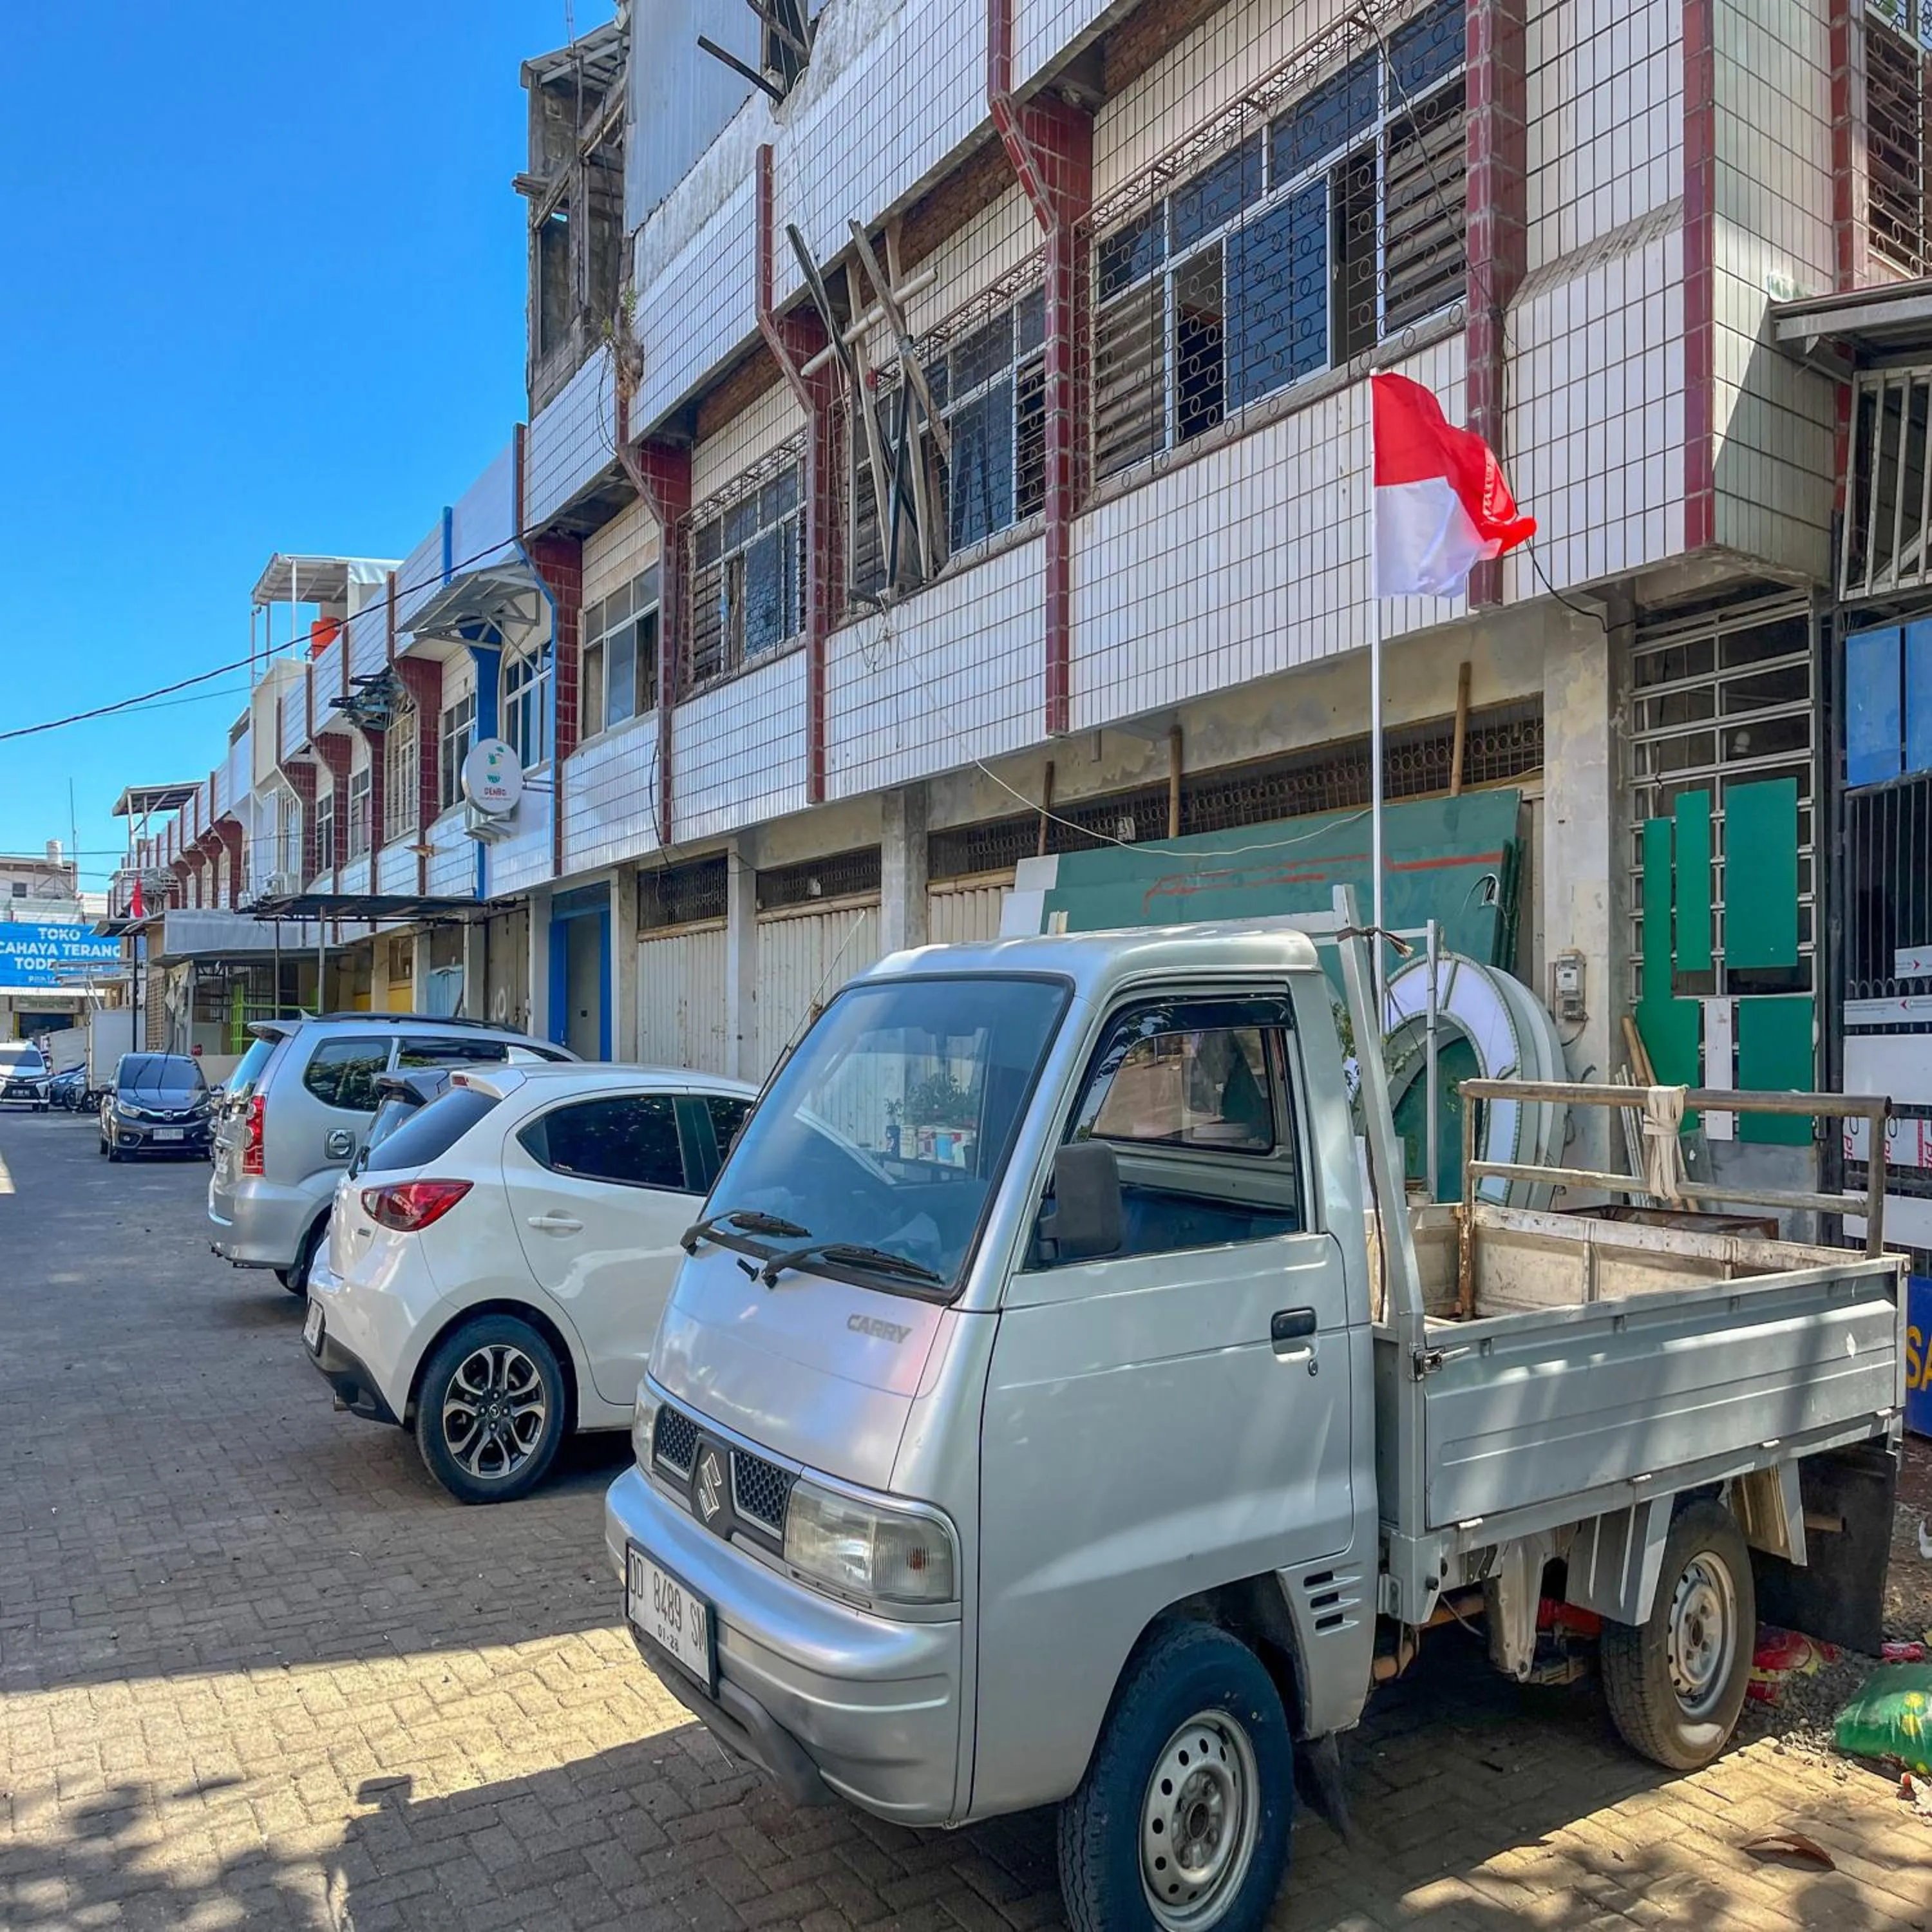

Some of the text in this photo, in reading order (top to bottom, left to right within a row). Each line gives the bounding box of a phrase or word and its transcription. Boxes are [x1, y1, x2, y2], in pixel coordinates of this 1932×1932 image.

[37, 927, 80, 941] TOKO
[847, 1314, 912, 1343] CARRY
[653, 1571, 682, 1633] 8489
